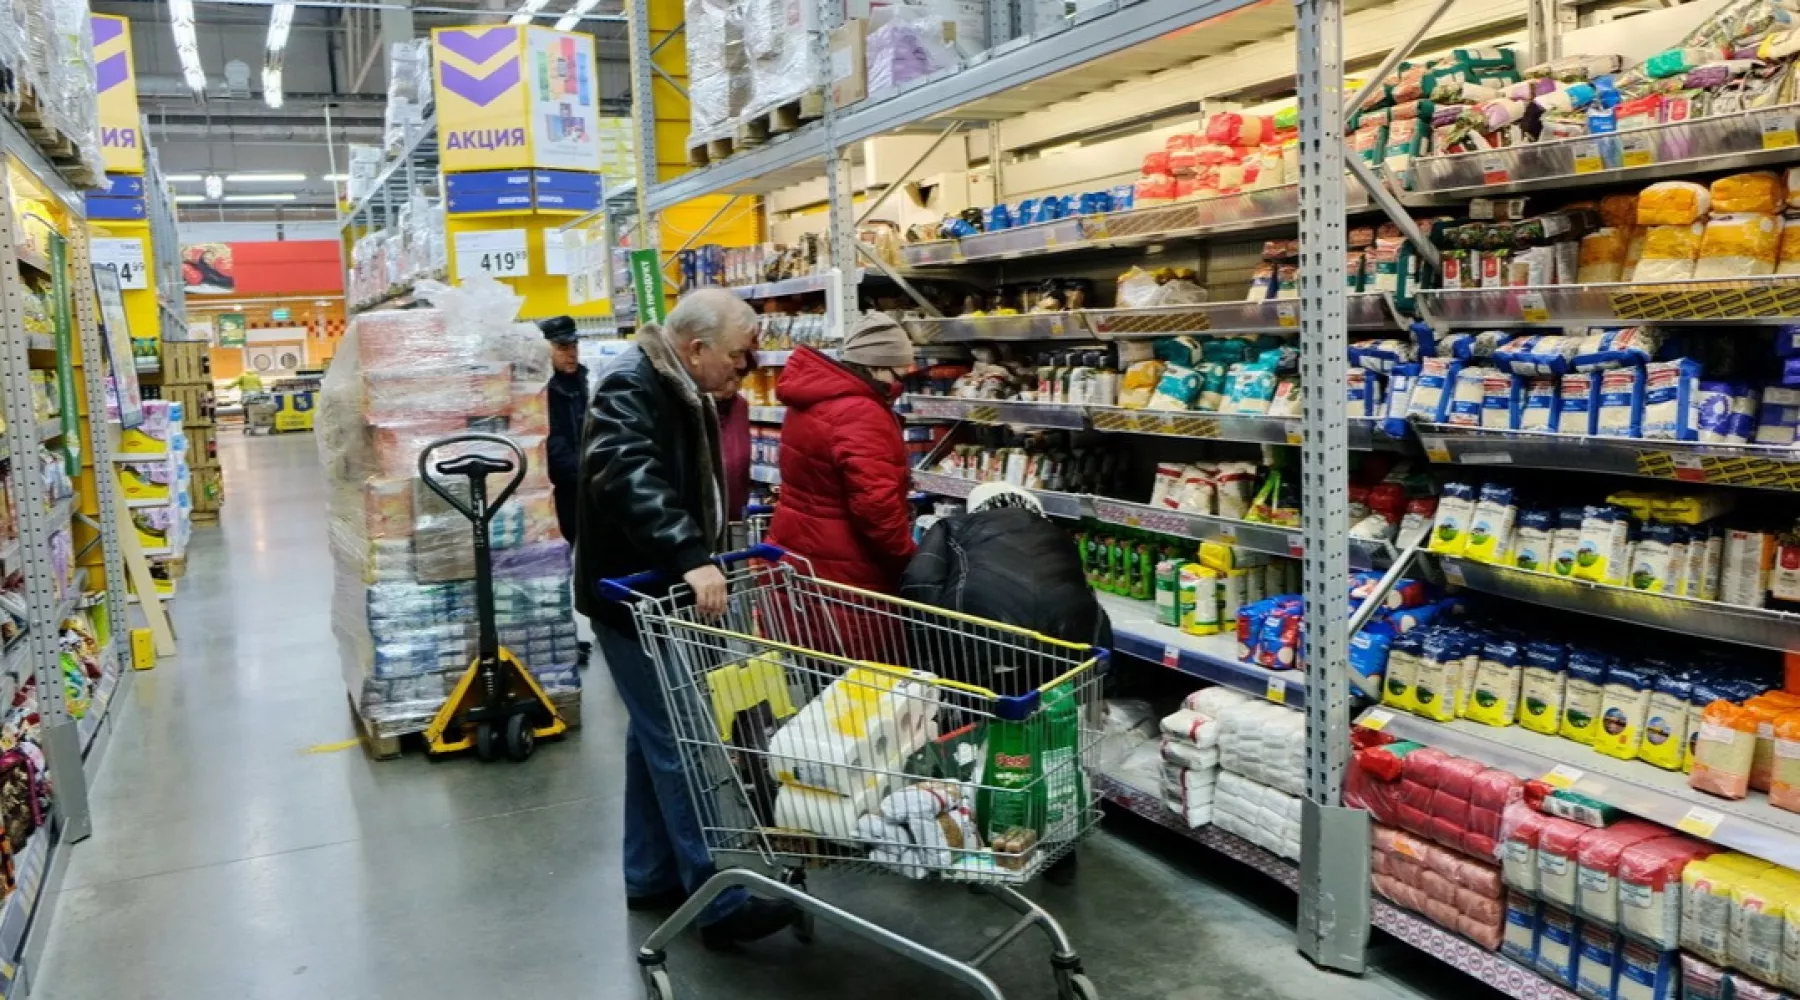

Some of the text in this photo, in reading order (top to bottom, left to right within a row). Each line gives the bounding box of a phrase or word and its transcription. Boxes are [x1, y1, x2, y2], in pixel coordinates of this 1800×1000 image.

[101, 126, 136, 149] ИЯ
[446, 128, 526, 151] АКЦИЯ
[481, 252, 515, 271] 419
[640, 260, 656, 305] ПРОДУКТ
